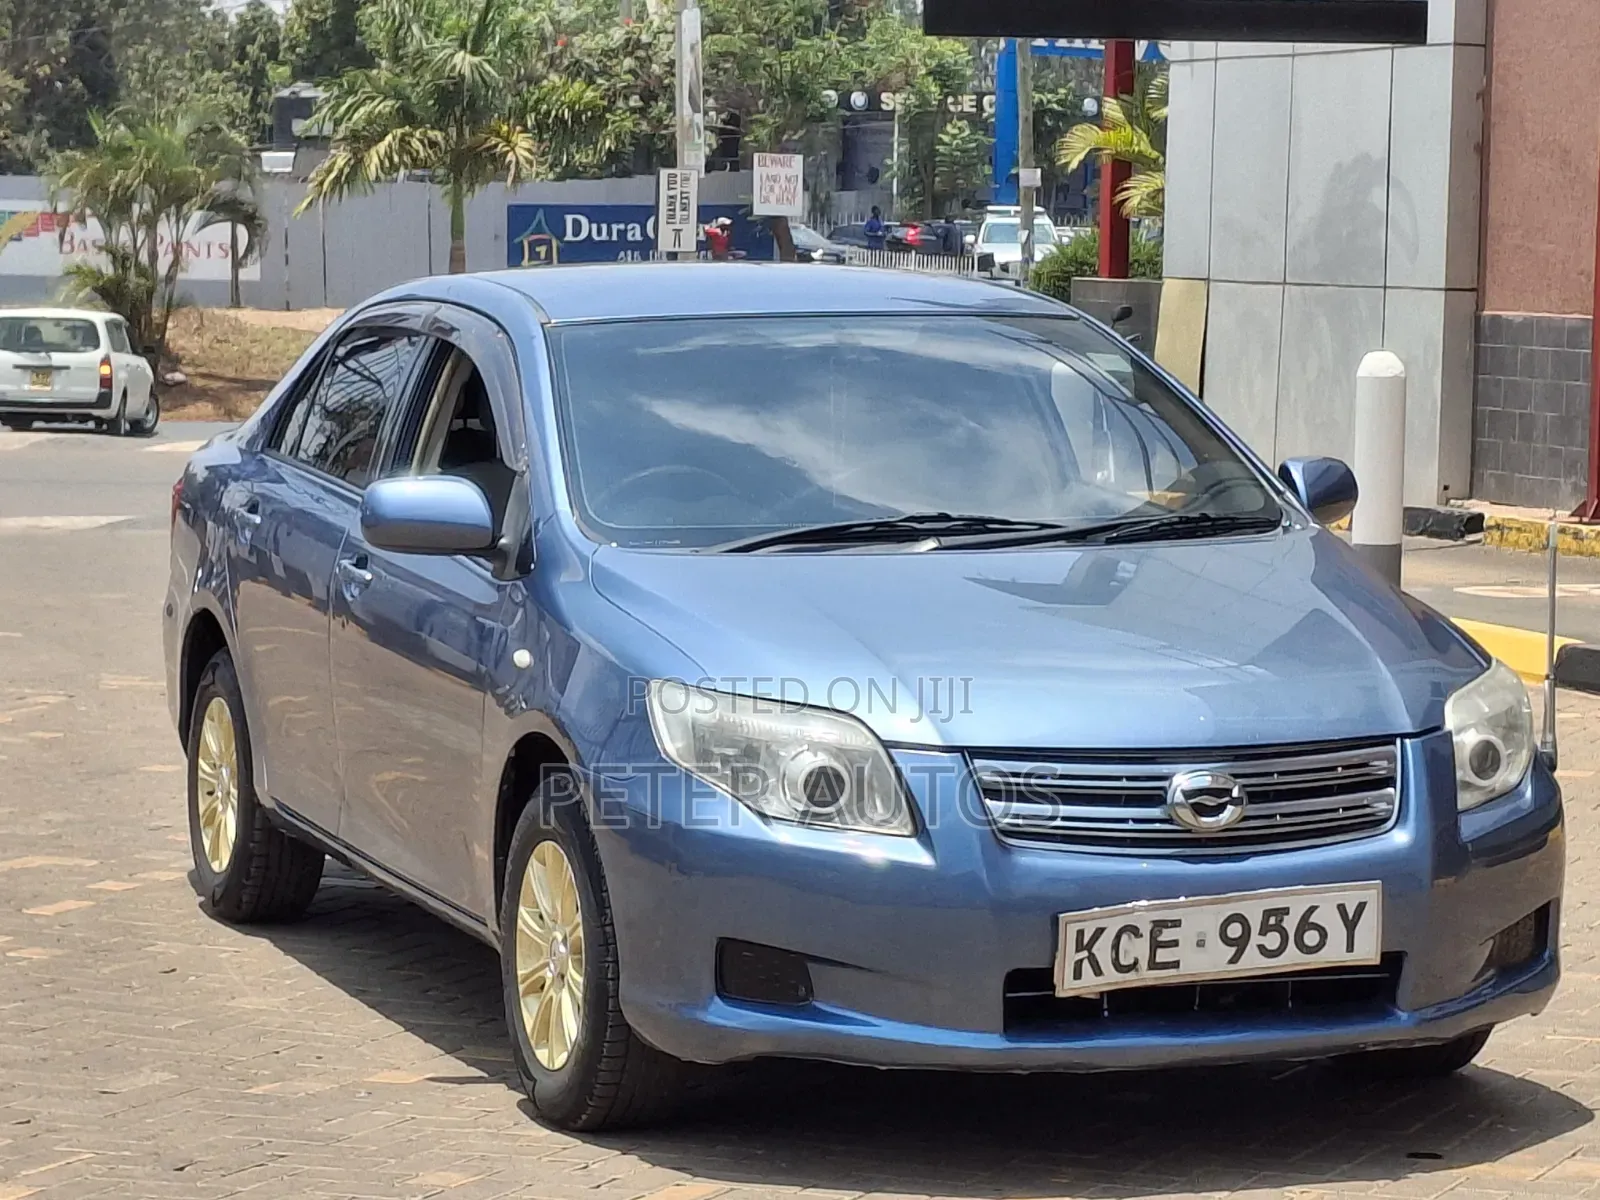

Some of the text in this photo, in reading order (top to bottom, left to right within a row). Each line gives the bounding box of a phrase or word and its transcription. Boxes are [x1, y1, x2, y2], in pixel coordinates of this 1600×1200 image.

[667, 173, 678, 191] YOU
[1072, 900, 1368, 981] KCE 956Y
